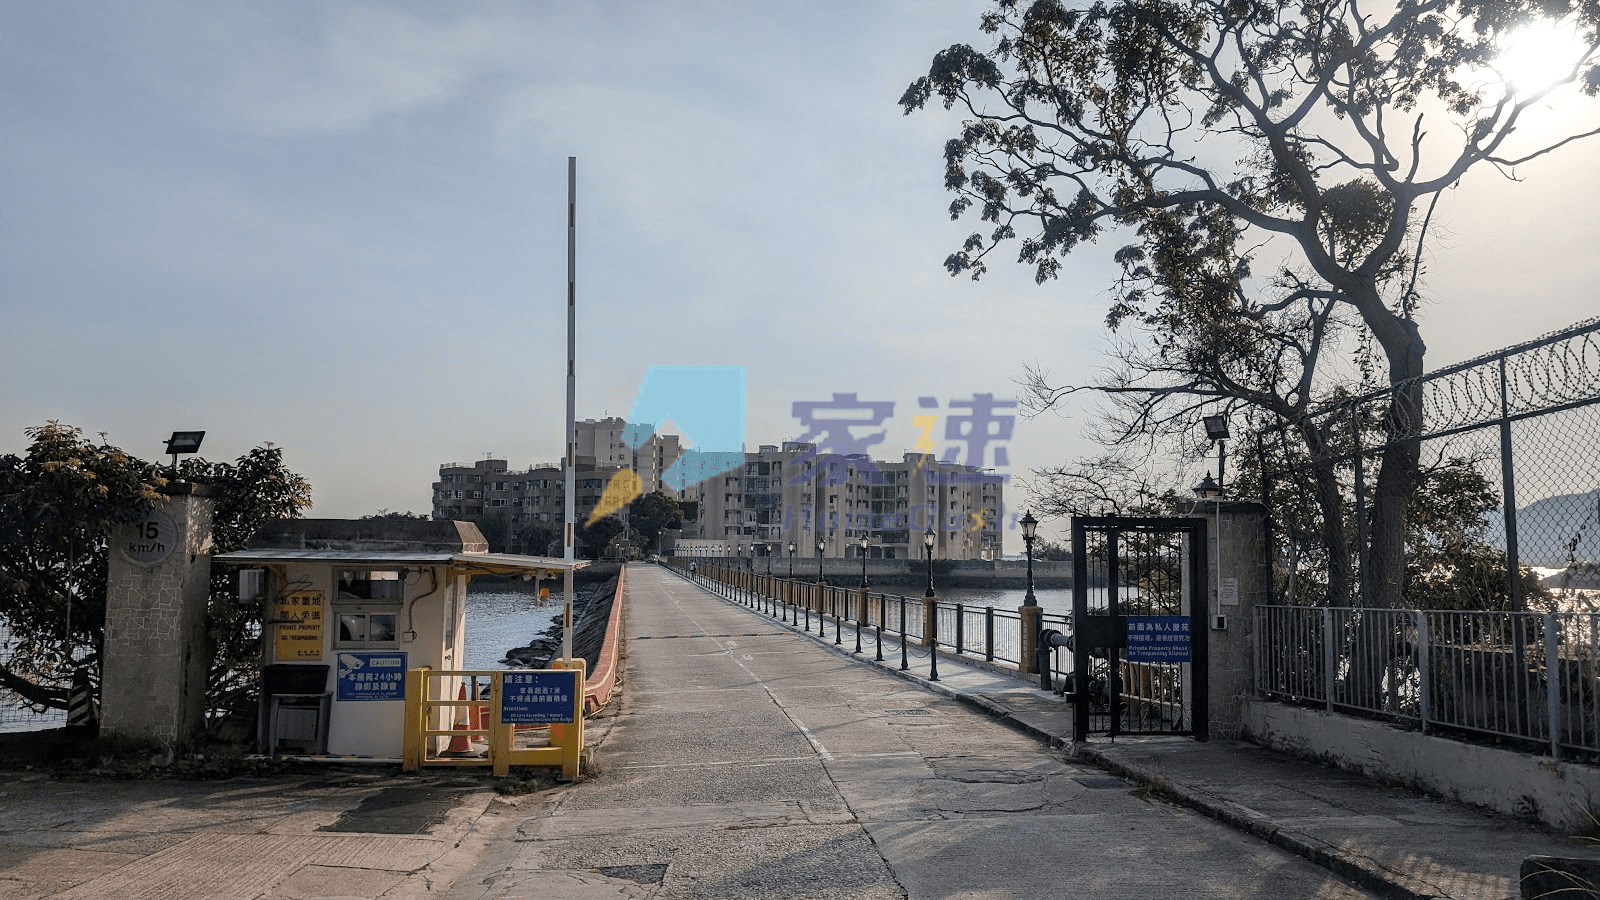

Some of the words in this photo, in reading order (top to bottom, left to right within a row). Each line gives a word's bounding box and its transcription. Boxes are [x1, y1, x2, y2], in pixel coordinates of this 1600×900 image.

[136, 521, 159, 539] 15
[129, 541, 165, 553] km/h
[280, 596, 321, 606] 私家重地
[1128, 622, 1190, 632] 前面為私人屋苑
[347, 672, 403, 682] 本屋苑24小時
